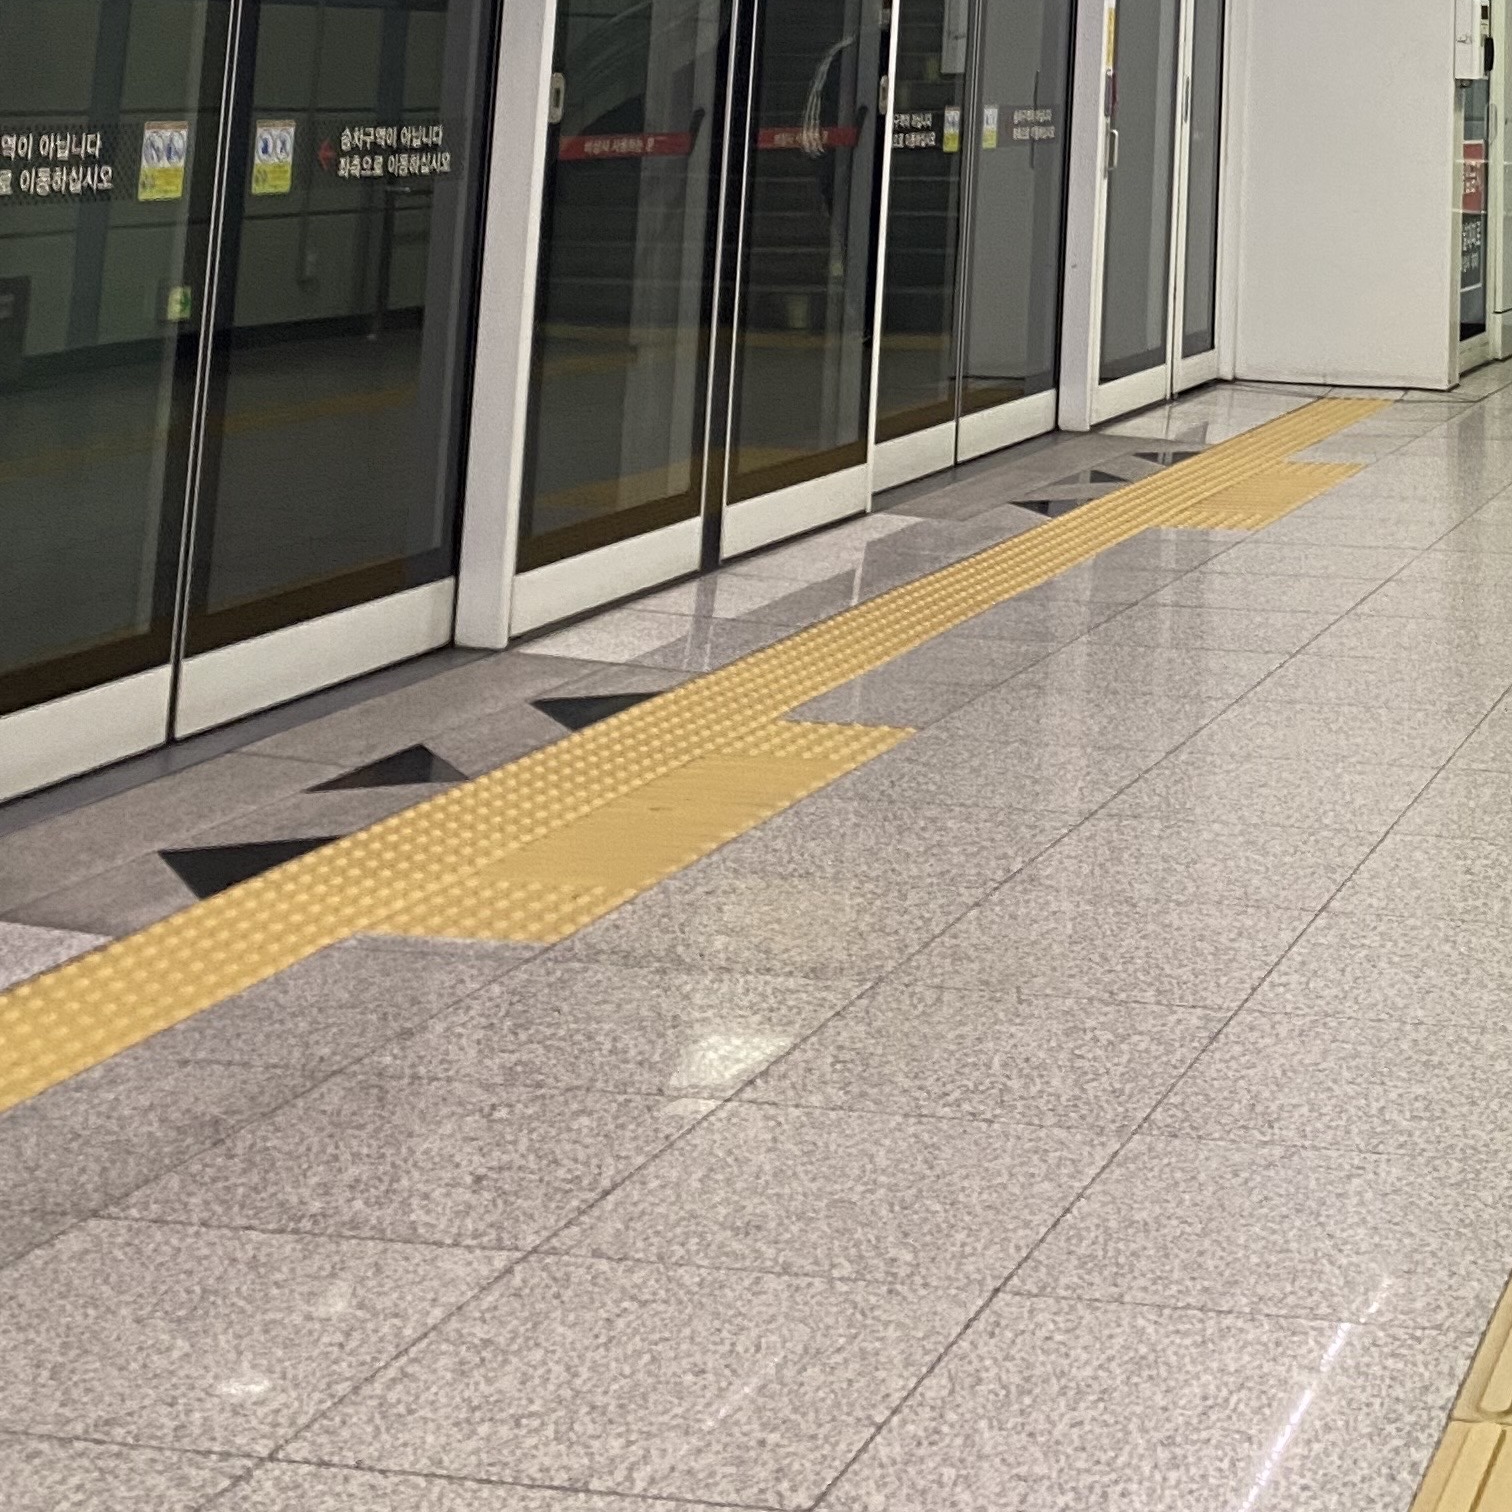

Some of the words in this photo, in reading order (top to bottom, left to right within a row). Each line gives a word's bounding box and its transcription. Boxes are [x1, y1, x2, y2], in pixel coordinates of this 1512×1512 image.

[40, 132, 102, 161] 아닙니다
[340, 126, 397, 152] 승차구역이
[400, 124, 443, 149] 아닙니다
[387, 151, 451, 177] 이동하십시오
[20, 165, 114, 197] 이동하십시오
